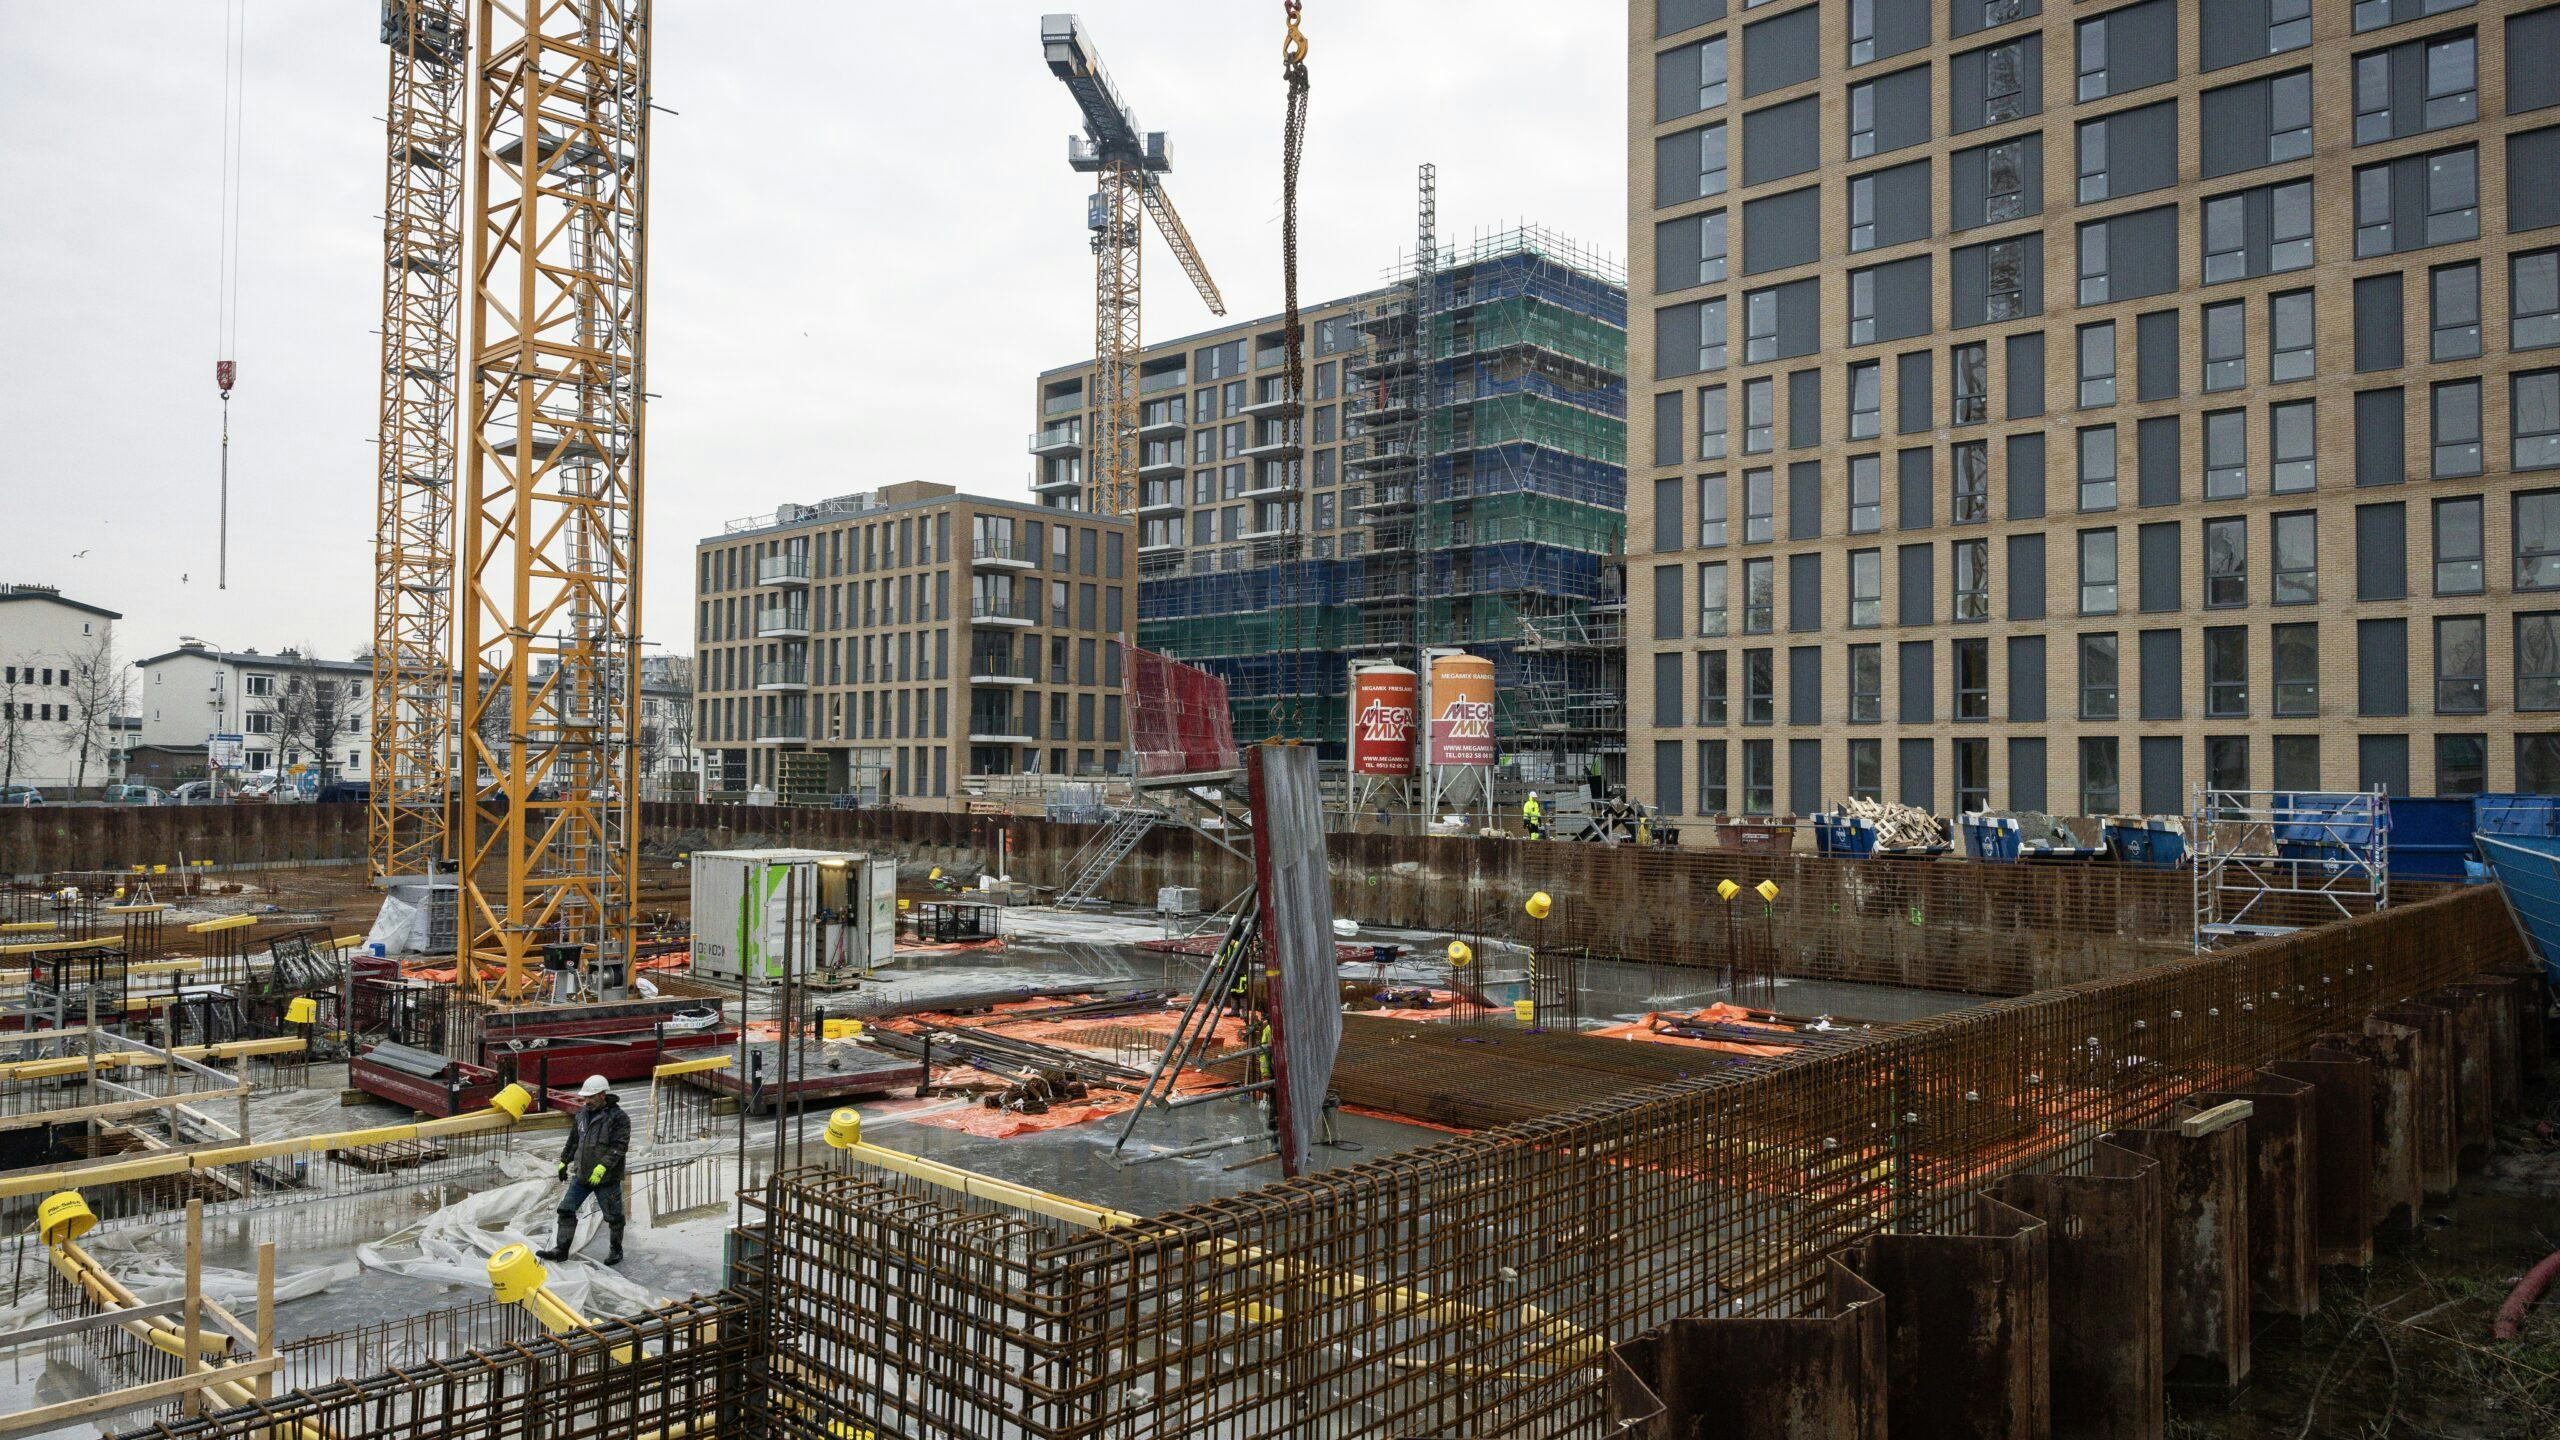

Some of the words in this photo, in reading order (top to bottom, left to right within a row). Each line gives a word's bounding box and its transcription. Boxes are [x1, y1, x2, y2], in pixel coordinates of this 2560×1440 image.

[1360, 708, 1413, 725] MEGA
[1443, 702, 1494, 721] MEGA
[1366, 723, 1404, 740] MIX
[1451, 720, 1488, 736] MIX
[1368, 876, 1377, 887] G
